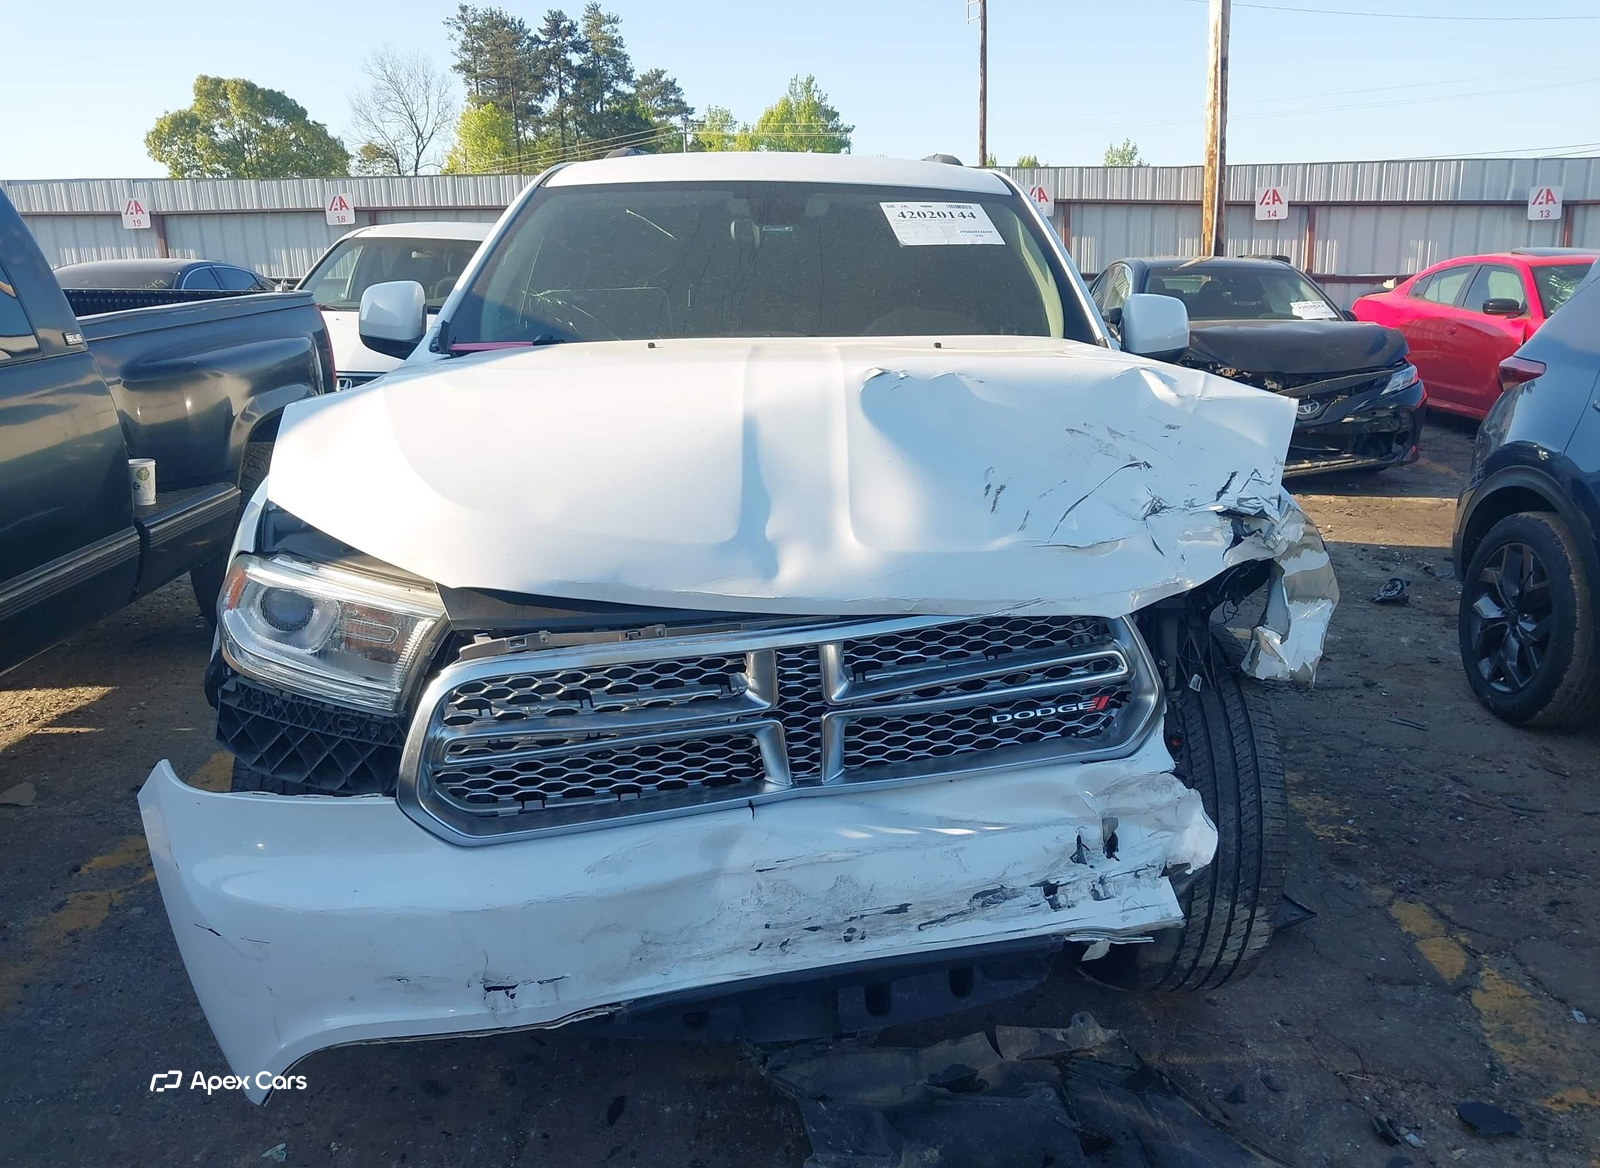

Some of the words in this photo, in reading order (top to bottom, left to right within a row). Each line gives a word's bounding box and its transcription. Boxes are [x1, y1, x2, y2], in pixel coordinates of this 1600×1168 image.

[897, 210, 977, 220] 42020144
[1266, 210, 1277, 218] 14
[1539, 209, 1551, 219] 13
[132, 219, 142, 228] 19
[336, 215, 347, 223] 18
[991, 700, 1097, 724] DODGE
